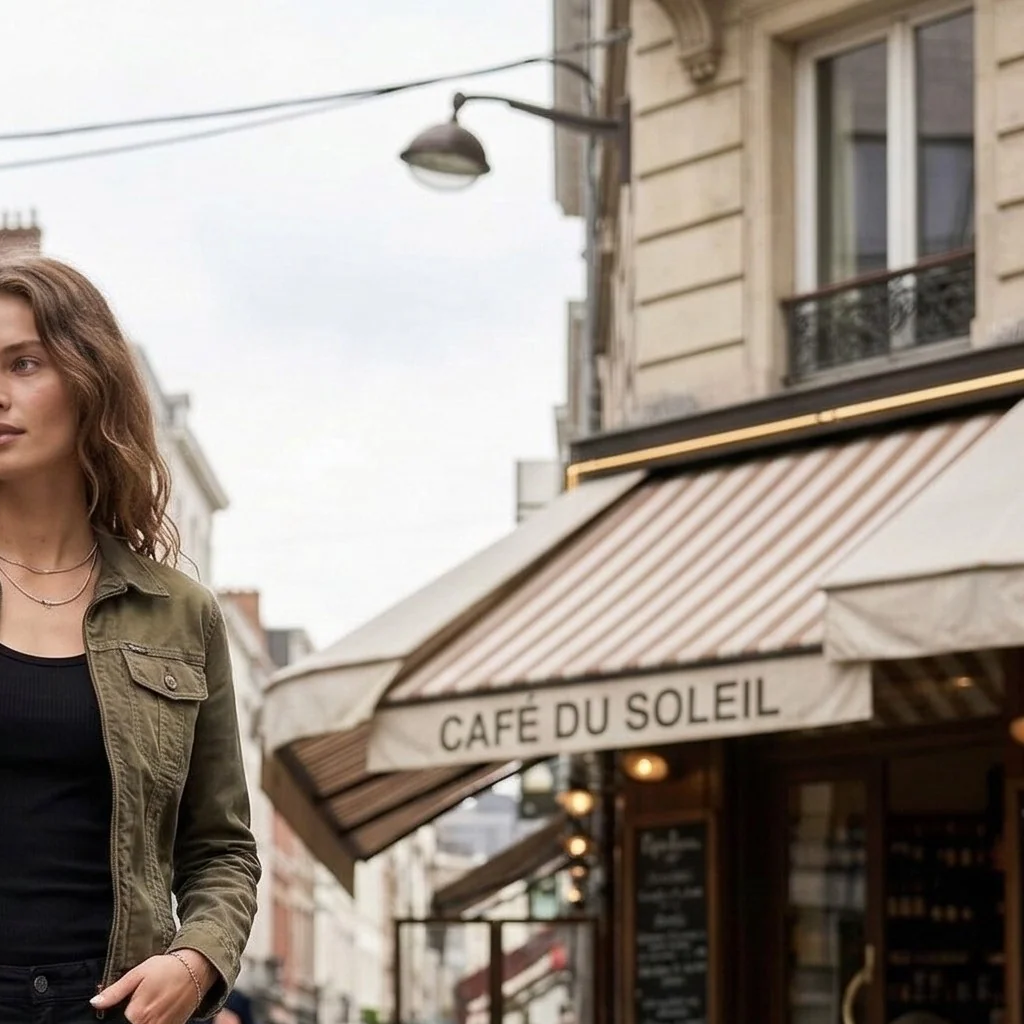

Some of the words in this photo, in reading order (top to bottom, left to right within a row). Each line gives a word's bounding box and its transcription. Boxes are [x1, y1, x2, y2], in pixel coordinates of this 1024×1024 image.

[440, 691, 539, 752] CAFÉ
[556, 697, 609, 738] DU
[626, 677, 780, 731] SOLEIL
